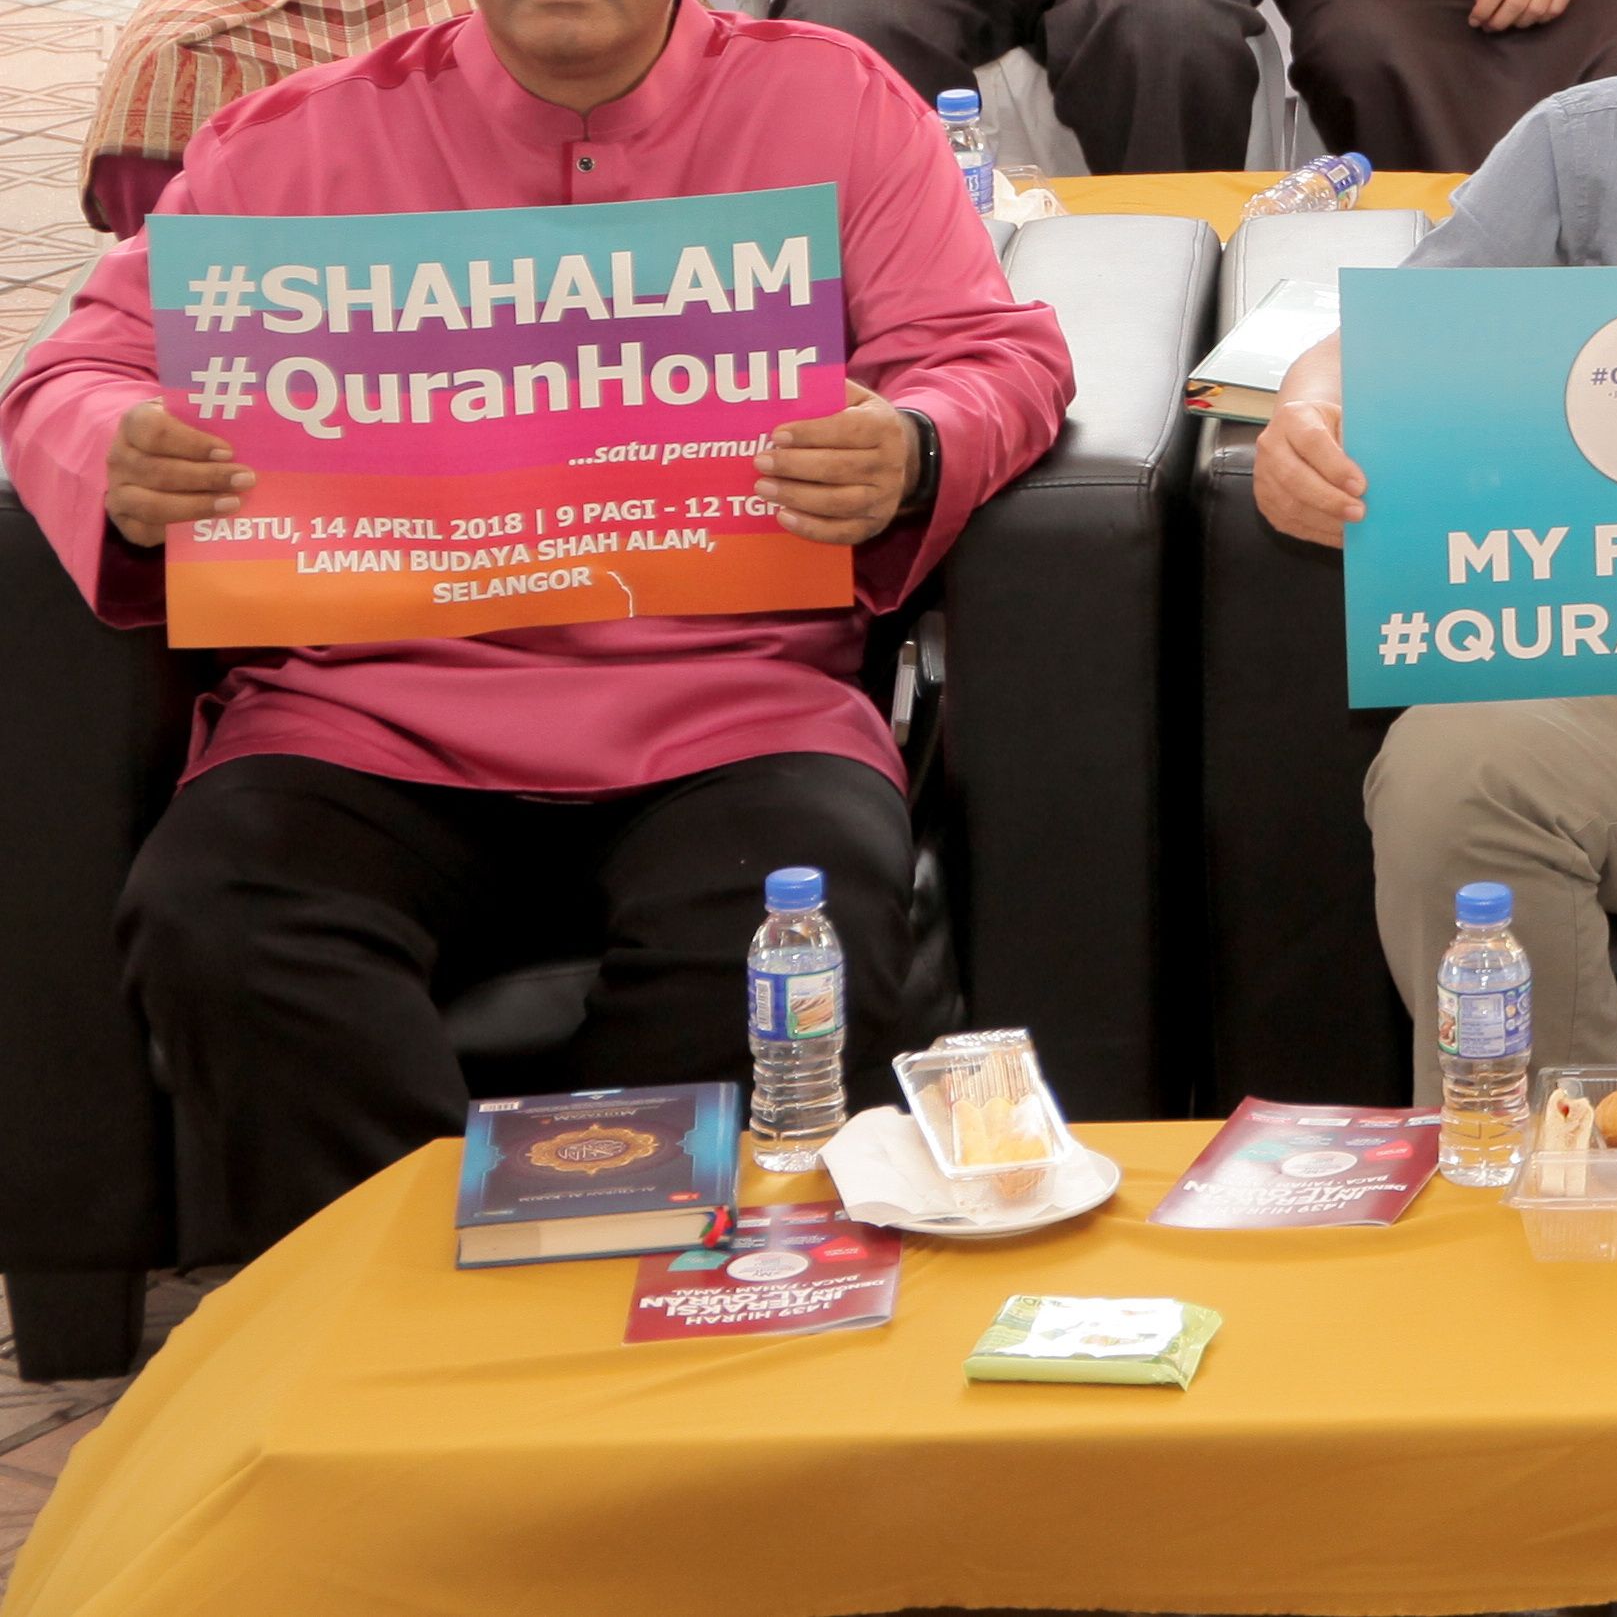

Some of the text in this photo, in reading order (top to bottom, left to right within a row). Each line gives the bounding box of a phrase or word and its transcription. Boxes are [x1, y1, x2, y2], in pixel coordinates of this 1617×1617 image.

[185, 236, 812, 334] #SHAHALAM
[189, 342, 818, 439] #QuranHour
[194, 495, 722, 545] SABTU, 14 APRIL 2018 9 PAGI 12
[296, 528, 717, 574] LAMAN BUDAYA SHAH ALAM,
[1447, 526, 1571, 584] MY
[433, 566, 593, 605] SELANGOR
[685, 1310, 770, 1326] HIJRAH
